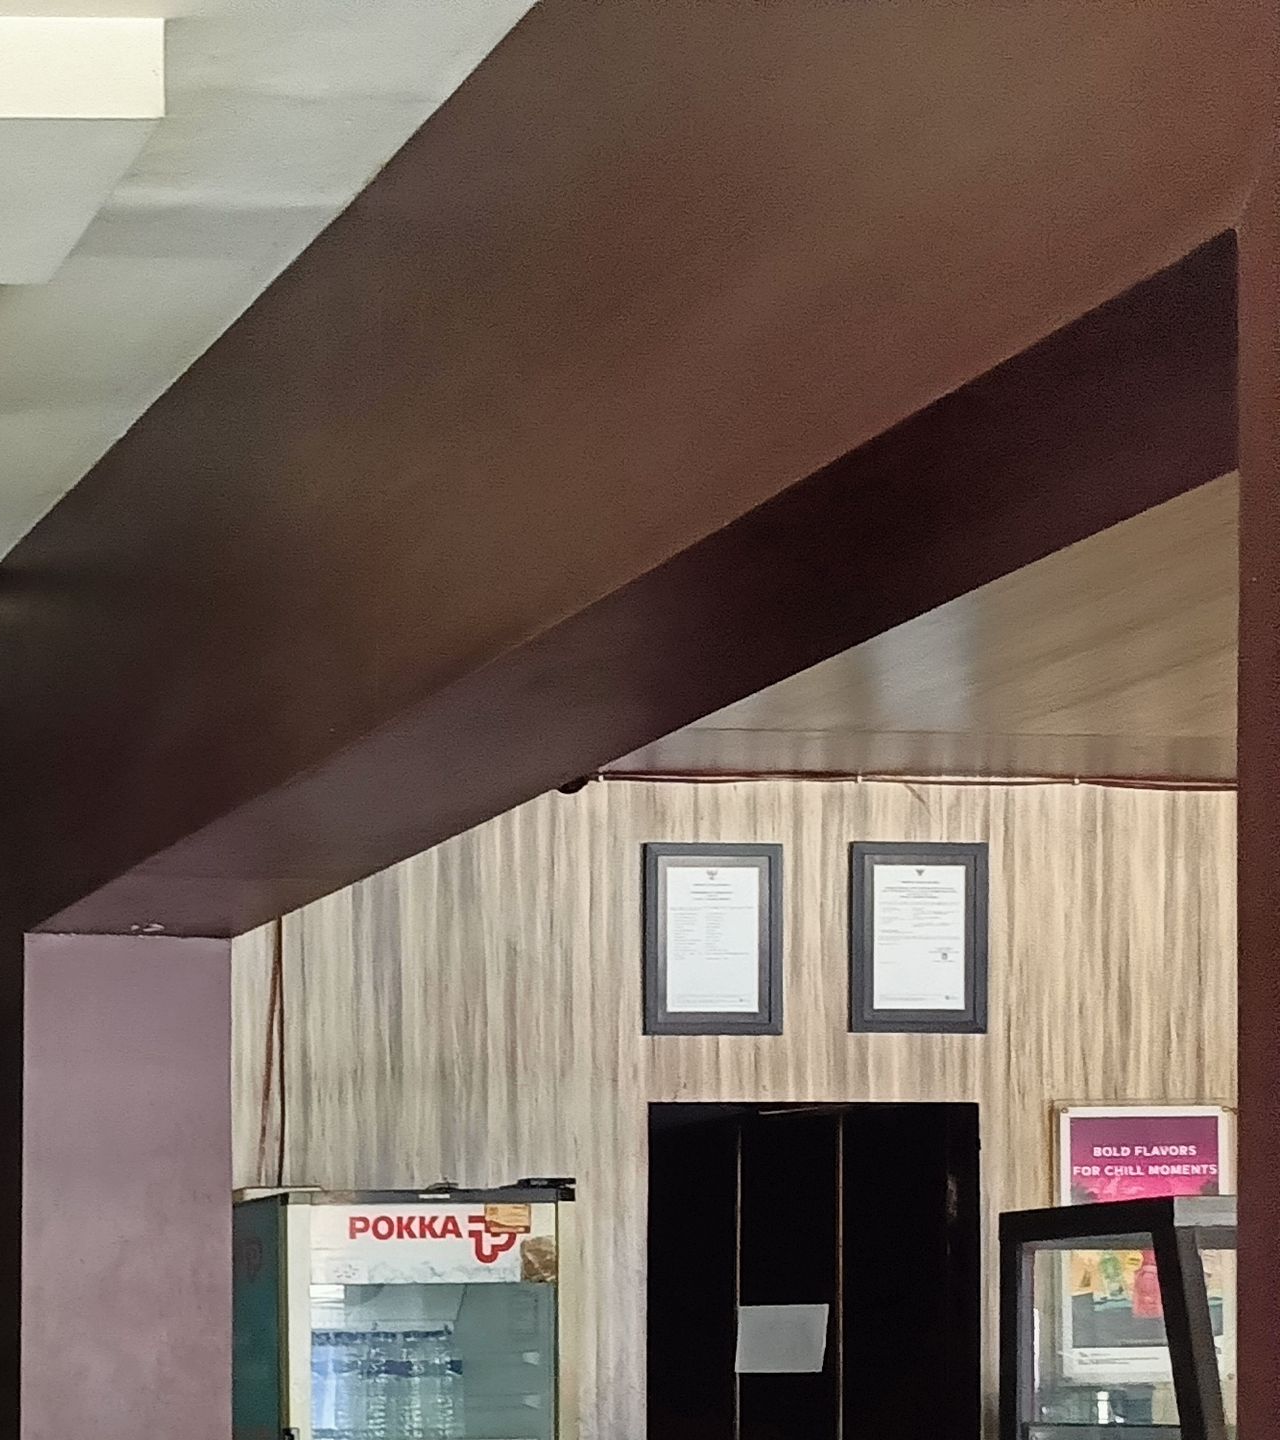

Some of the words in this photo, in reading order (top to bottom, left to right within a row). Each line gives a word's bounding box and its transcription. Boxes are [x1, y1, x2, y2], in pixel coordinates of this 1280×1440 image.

[1093, 1146, 1131, 1157] BOLD
[1134, 1145, 1197, 1157] FLAVORS
[1073, 1165, 1100, 1176] FOR
[1104, 1165, 1144, 1176] CHILL
[1148, 1164, 1217, 1176] MOMENTS
[349, 1215, 462, 1240] POKKA
